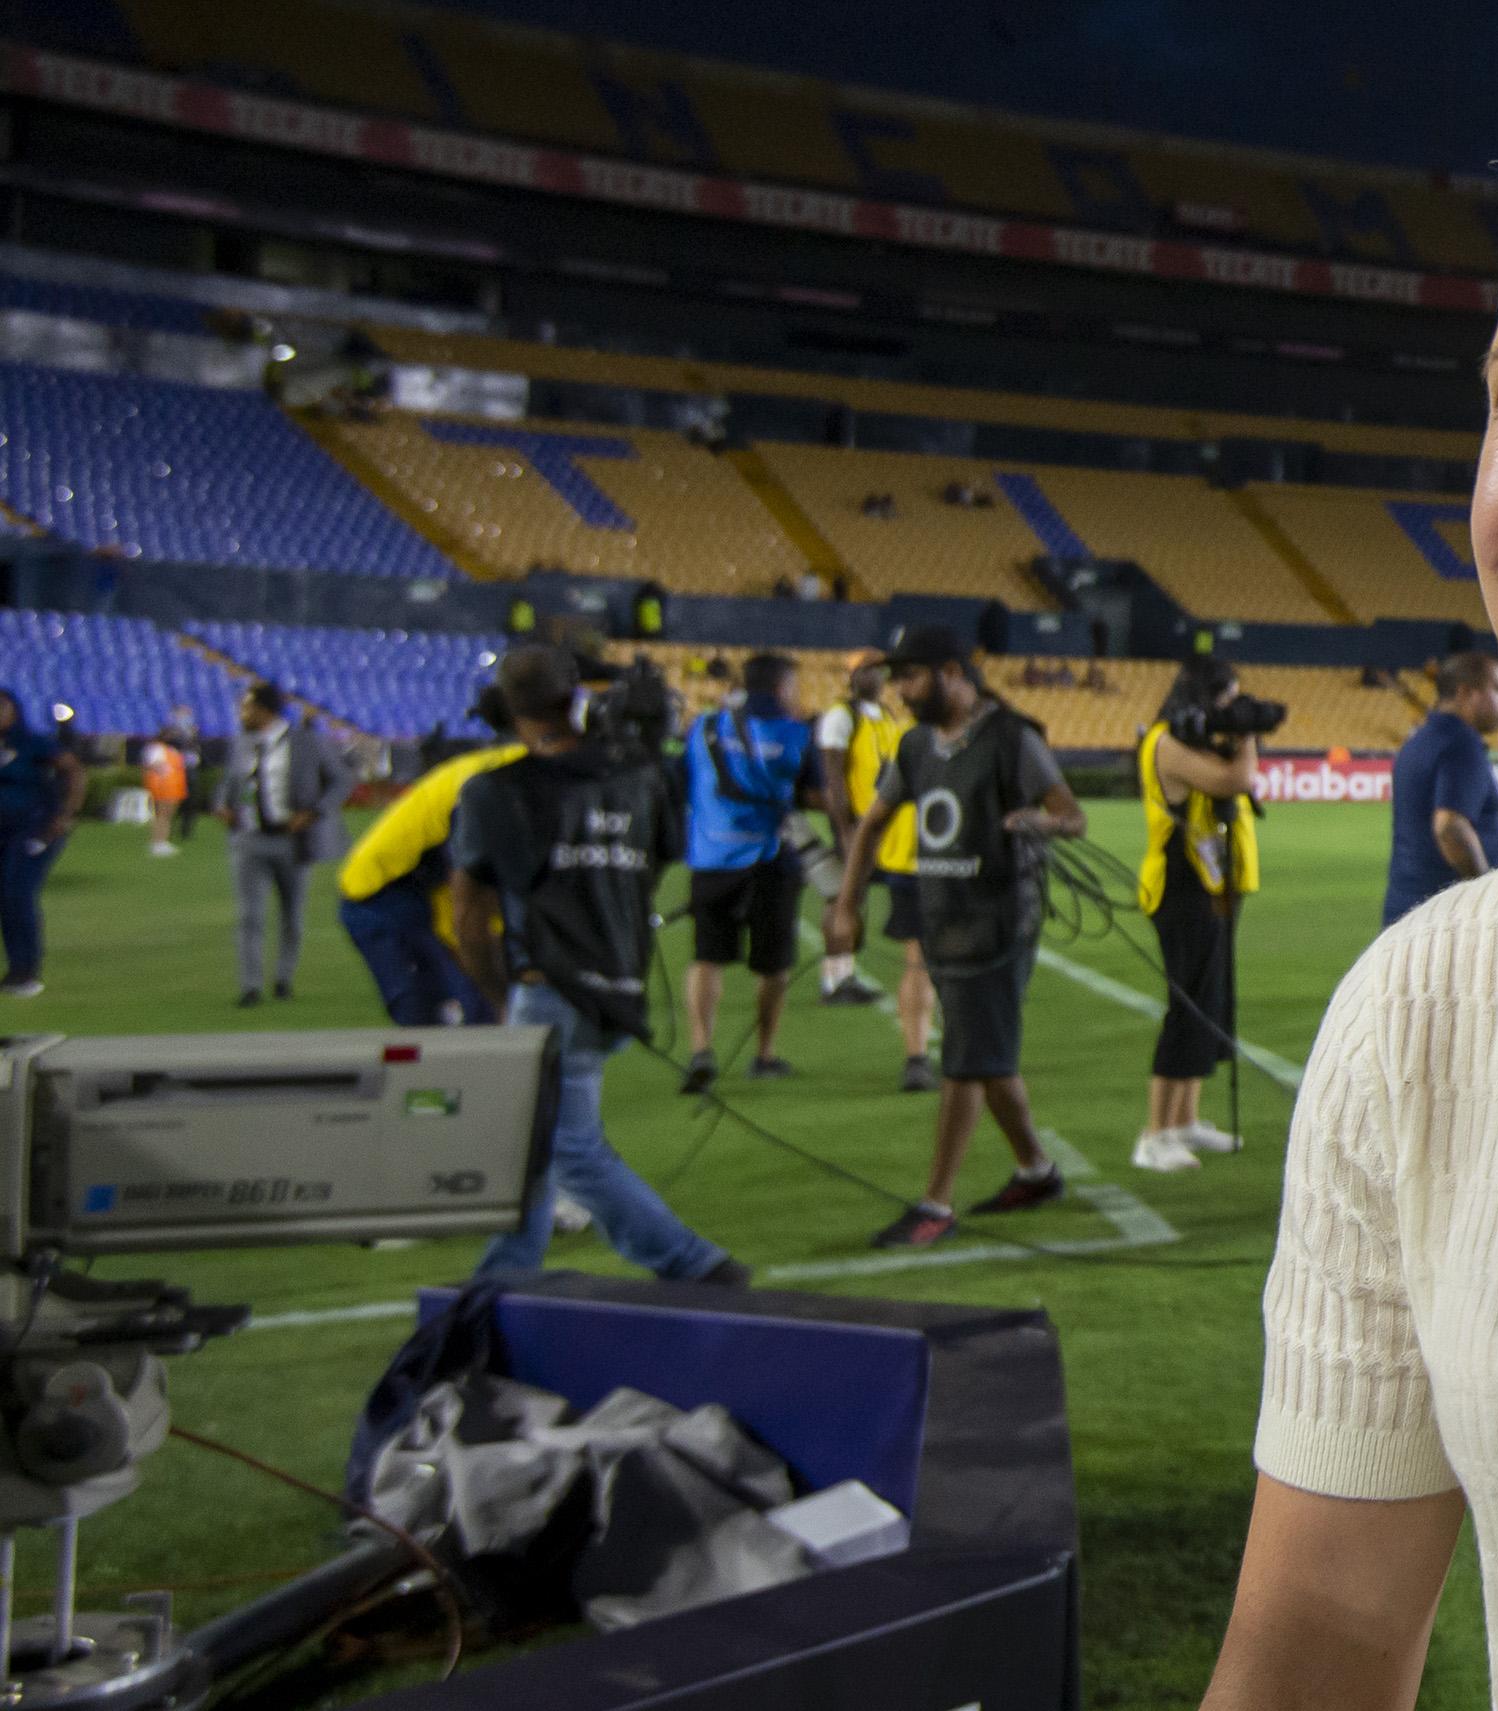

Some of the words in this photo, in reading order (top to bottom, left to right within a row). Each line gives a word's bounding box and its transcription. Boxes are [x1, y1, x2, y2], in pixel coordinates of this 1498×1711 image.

[894, 205, 1003, 256] TECATE
[1053, 229, 1154, 272] TECATE
[1202, 246, 1295, 293] TECATE
[1330, 263, 1421, 303] TECATE
